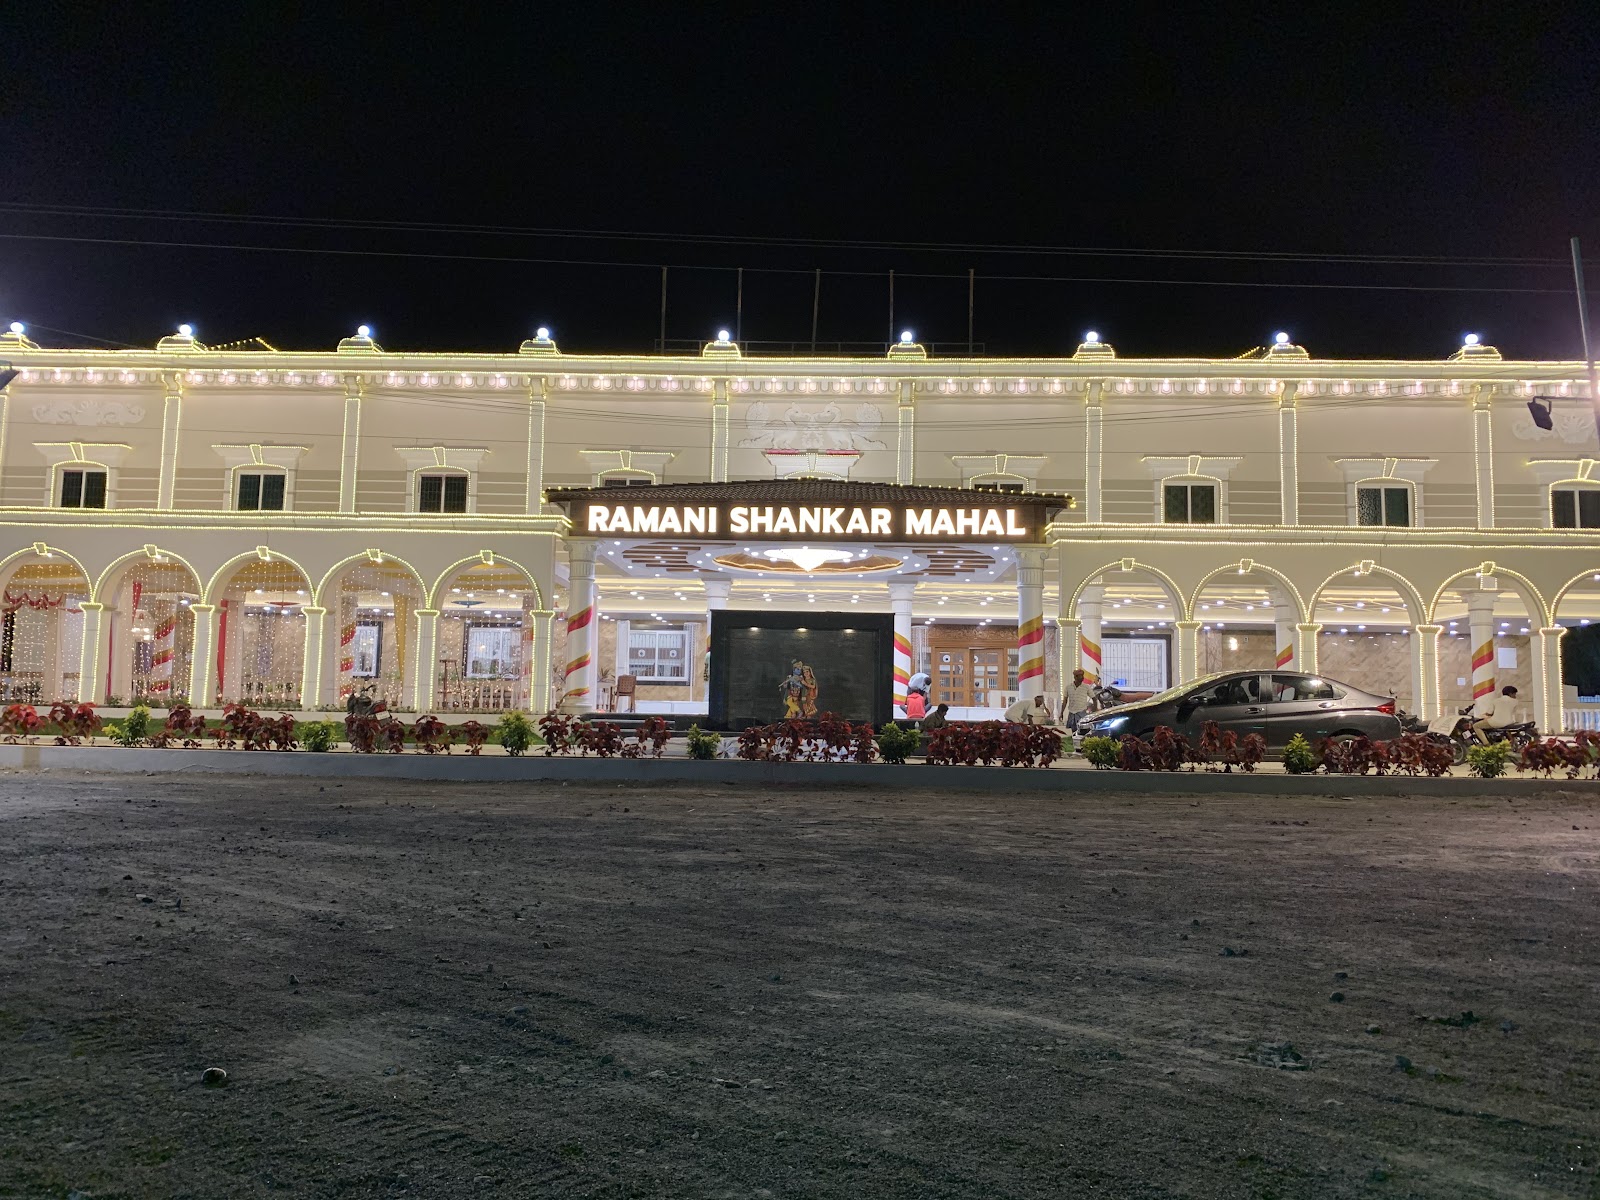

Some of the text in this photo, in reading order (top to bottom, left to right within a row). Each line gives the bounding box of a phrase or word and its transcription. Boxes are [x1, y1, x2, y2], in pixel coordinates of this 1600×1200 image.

[587, 505, 1027, 536] RAMANI SHANKAR MAHAL
